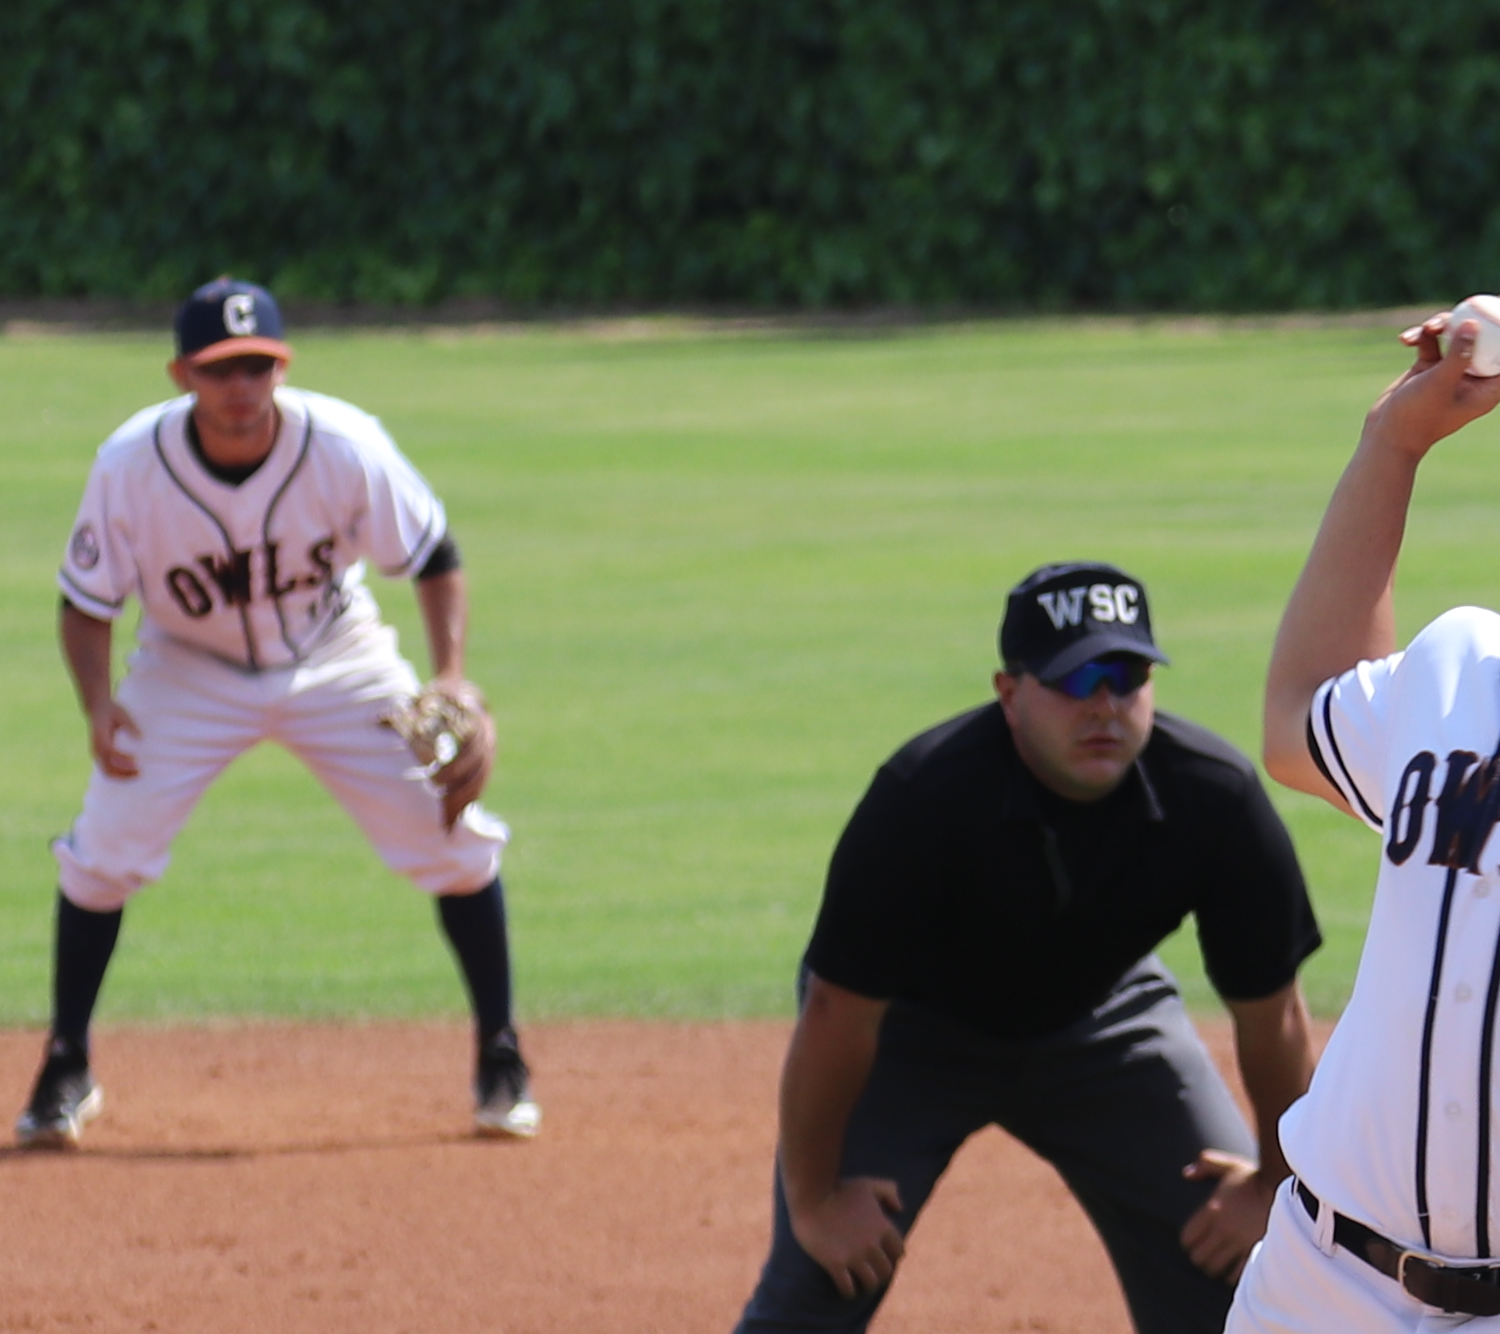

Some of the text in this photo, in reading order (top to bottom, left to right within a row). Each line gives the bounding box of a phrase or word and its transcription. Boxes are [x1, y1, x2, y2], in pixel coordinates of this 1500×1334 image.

[223, 294, 257, 335] C
[166, 534, 336, 618] OWLS
[1037, 584, 1139, 630] WSC
